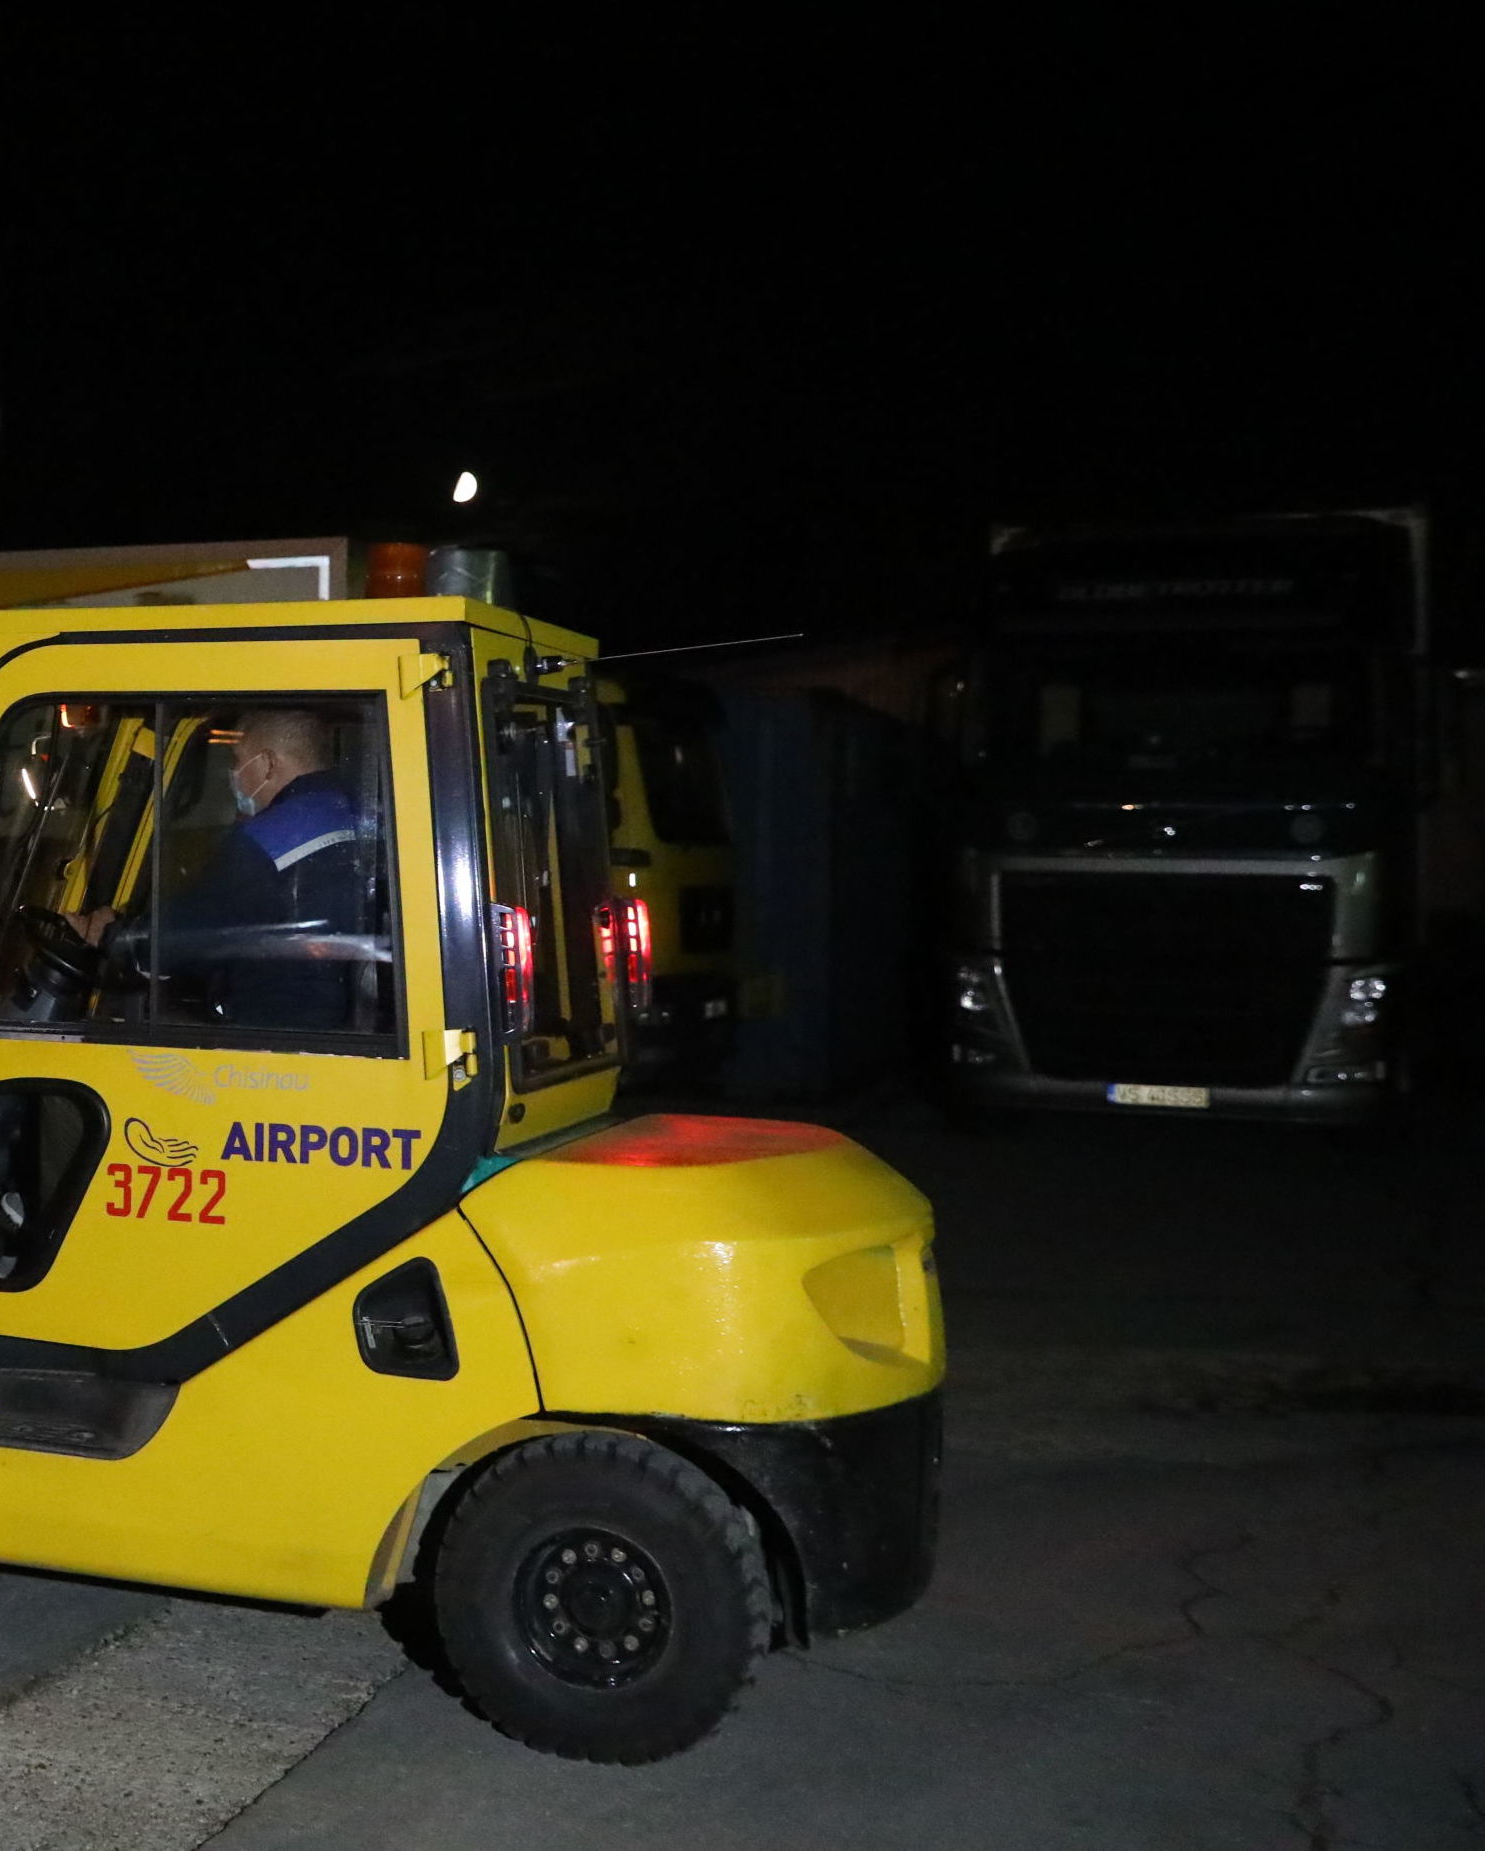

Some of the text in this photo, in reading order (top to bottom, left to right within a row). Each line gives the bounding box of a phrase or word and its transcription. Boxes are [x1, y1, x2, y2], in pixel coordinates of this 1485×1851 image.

[214, 1064, 311, 1091] Chisinau
[220, 1121, 422, 1171] AIRPORT
[105, 1163, 226, 1226] 3722
